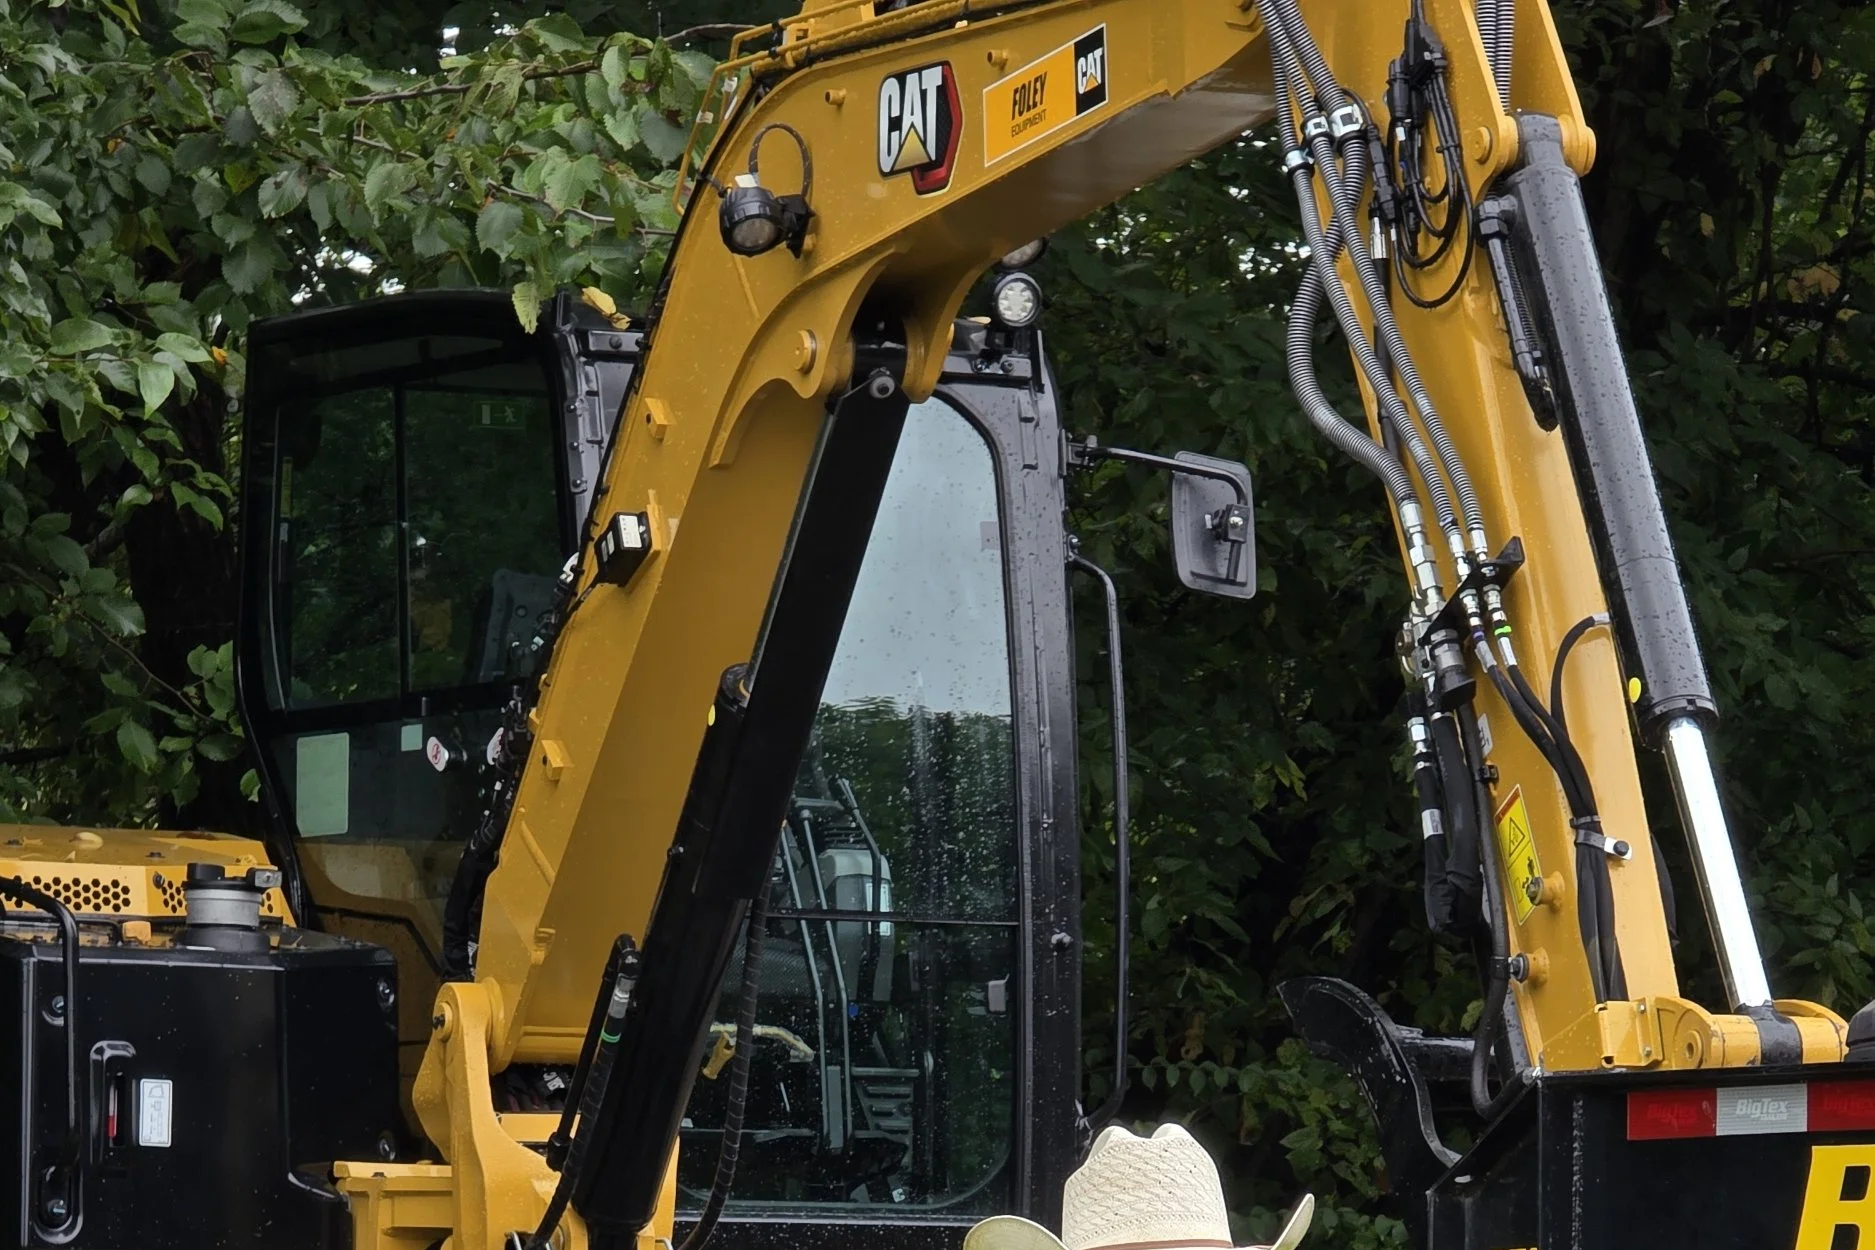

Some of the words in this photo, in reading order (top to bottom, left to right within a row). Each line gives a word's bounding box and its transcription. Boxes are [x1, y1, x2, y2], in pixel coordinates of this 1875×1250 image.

[1077, 47, 1103, 95] CAT
[879, 65, 943, 173] CAT
[1011, 71, 1048, 121] FOLEY
[1011, 108, 1048, 138] EQUIPMENT
